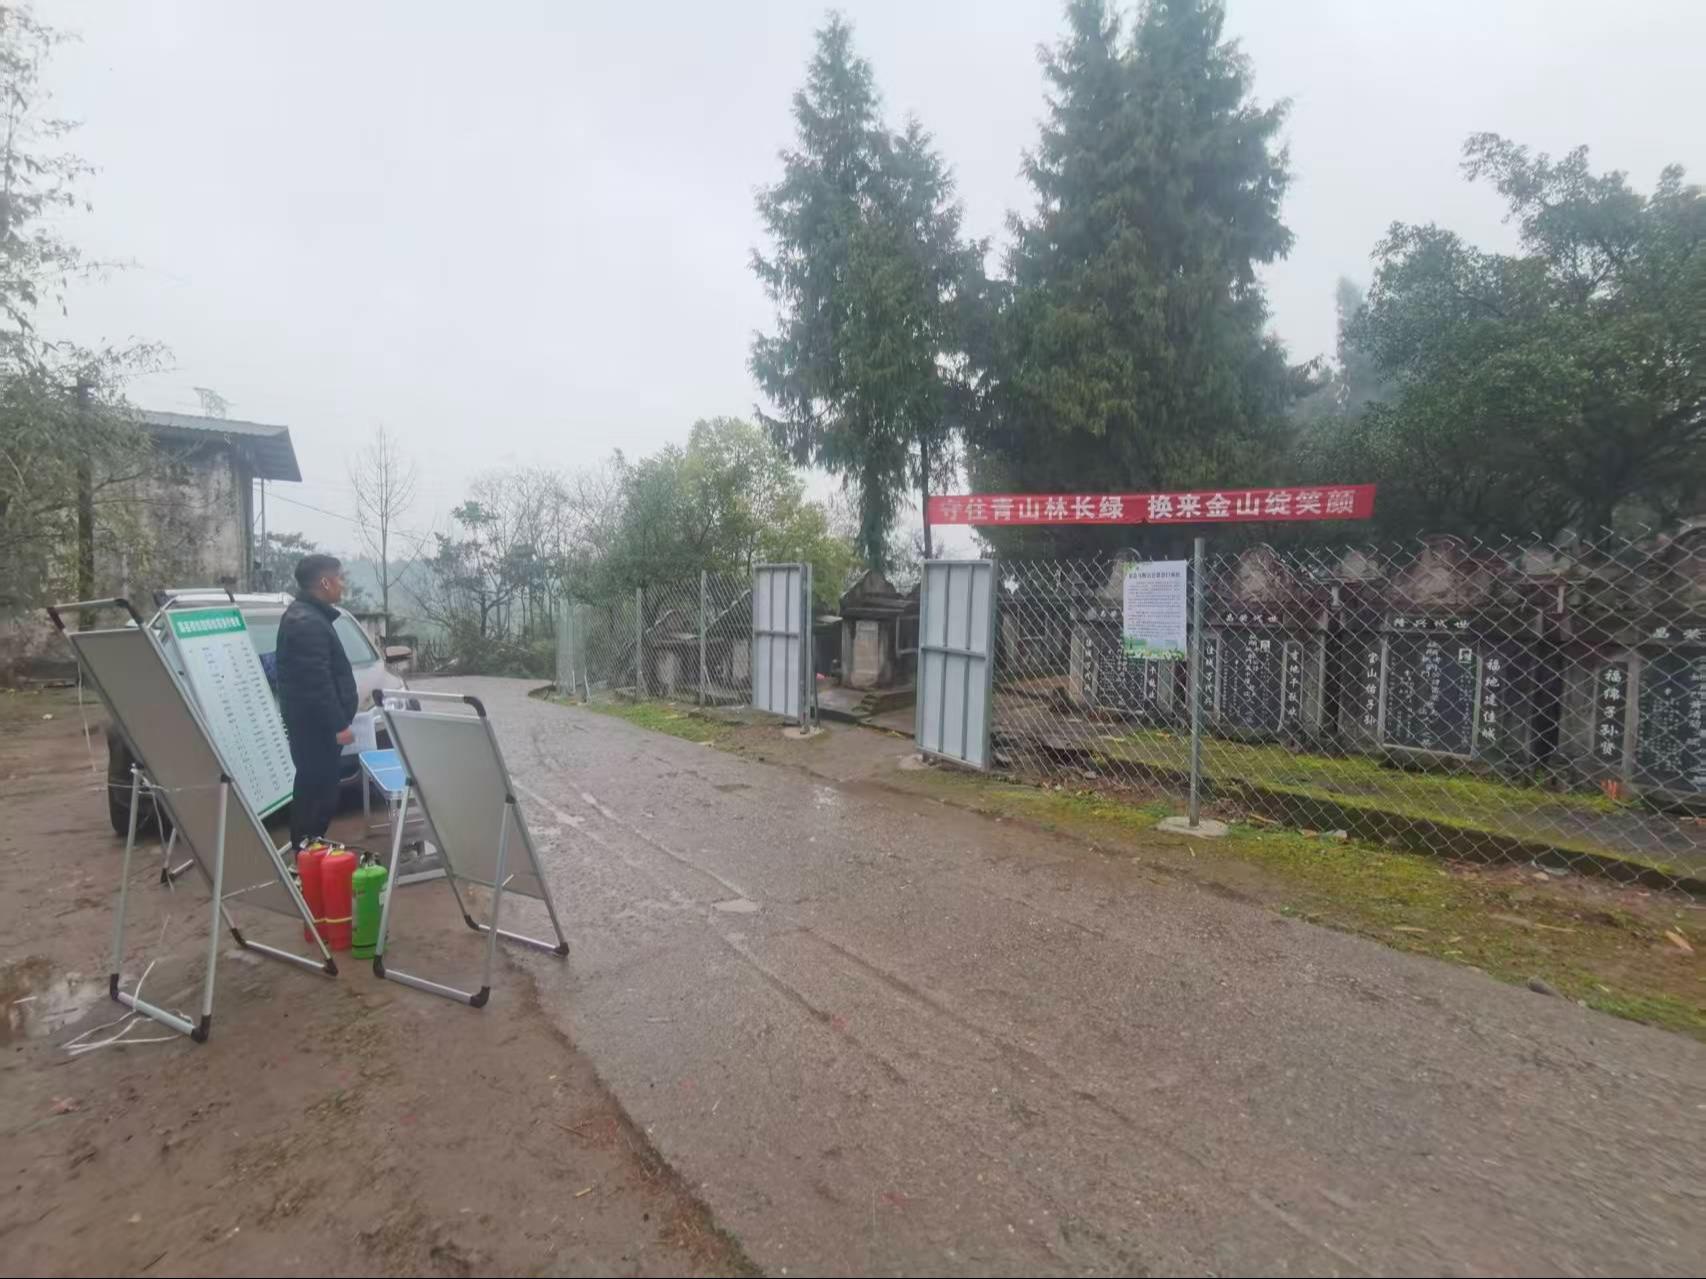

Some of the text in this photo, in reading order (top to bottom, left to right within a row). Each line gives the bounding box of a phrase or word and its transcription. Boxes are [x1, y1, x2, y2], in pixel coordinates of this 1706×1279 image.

[940, 489, 1356, 520] 守住青山林长绿 换来金山绽笑颜
